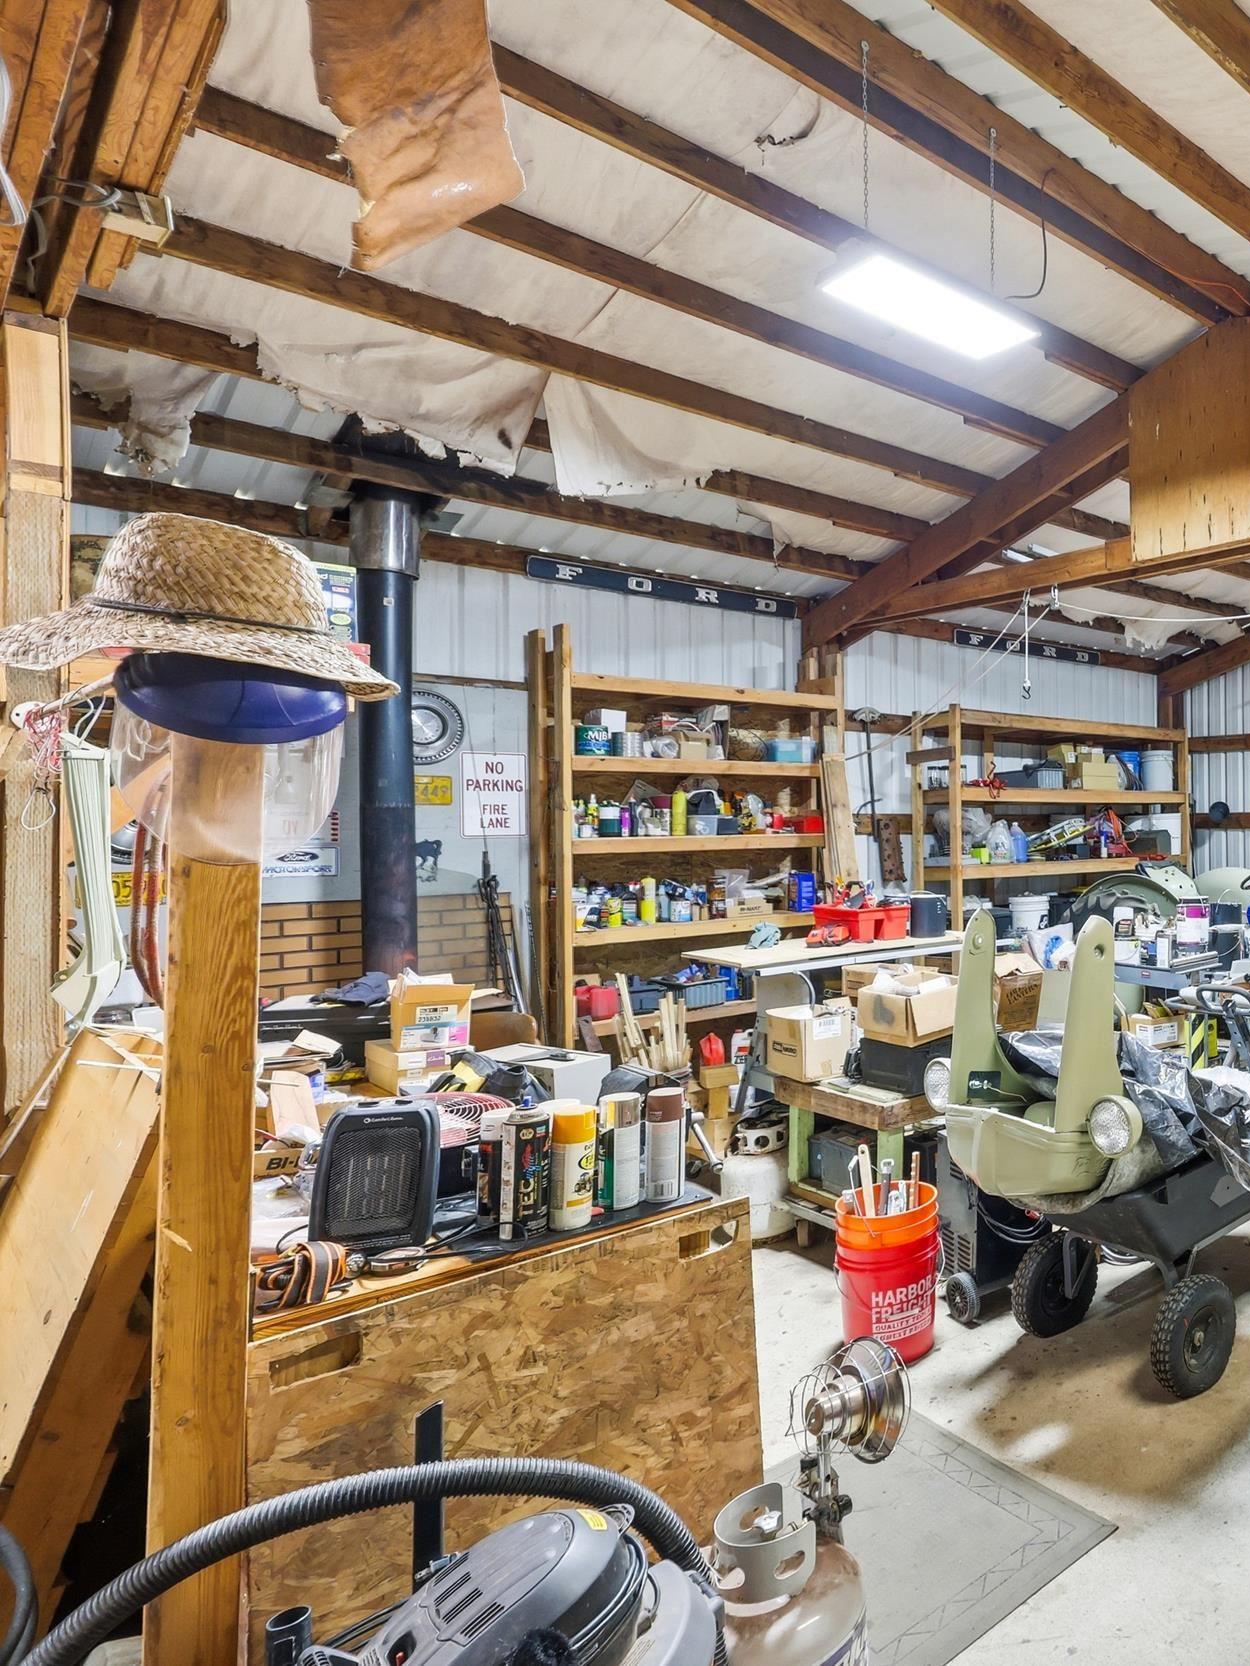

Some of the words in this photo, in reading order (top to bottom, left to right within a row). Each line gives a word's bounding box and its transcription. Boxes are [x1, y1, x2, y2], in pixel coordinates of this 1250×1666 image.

[555, 563, 778, 614] FORD
[969, 633, 1089, 662] FORD
[485, 761, 504, 774] NO
[466, 778, 524, 792] PARKING
[482, 804, 508, 815] FIRE
[480, 817, 510, 829] LANE
[871, 1275, 932, 1308] HARBOR
[872, 1291, 932, 1323] FREIGHT
